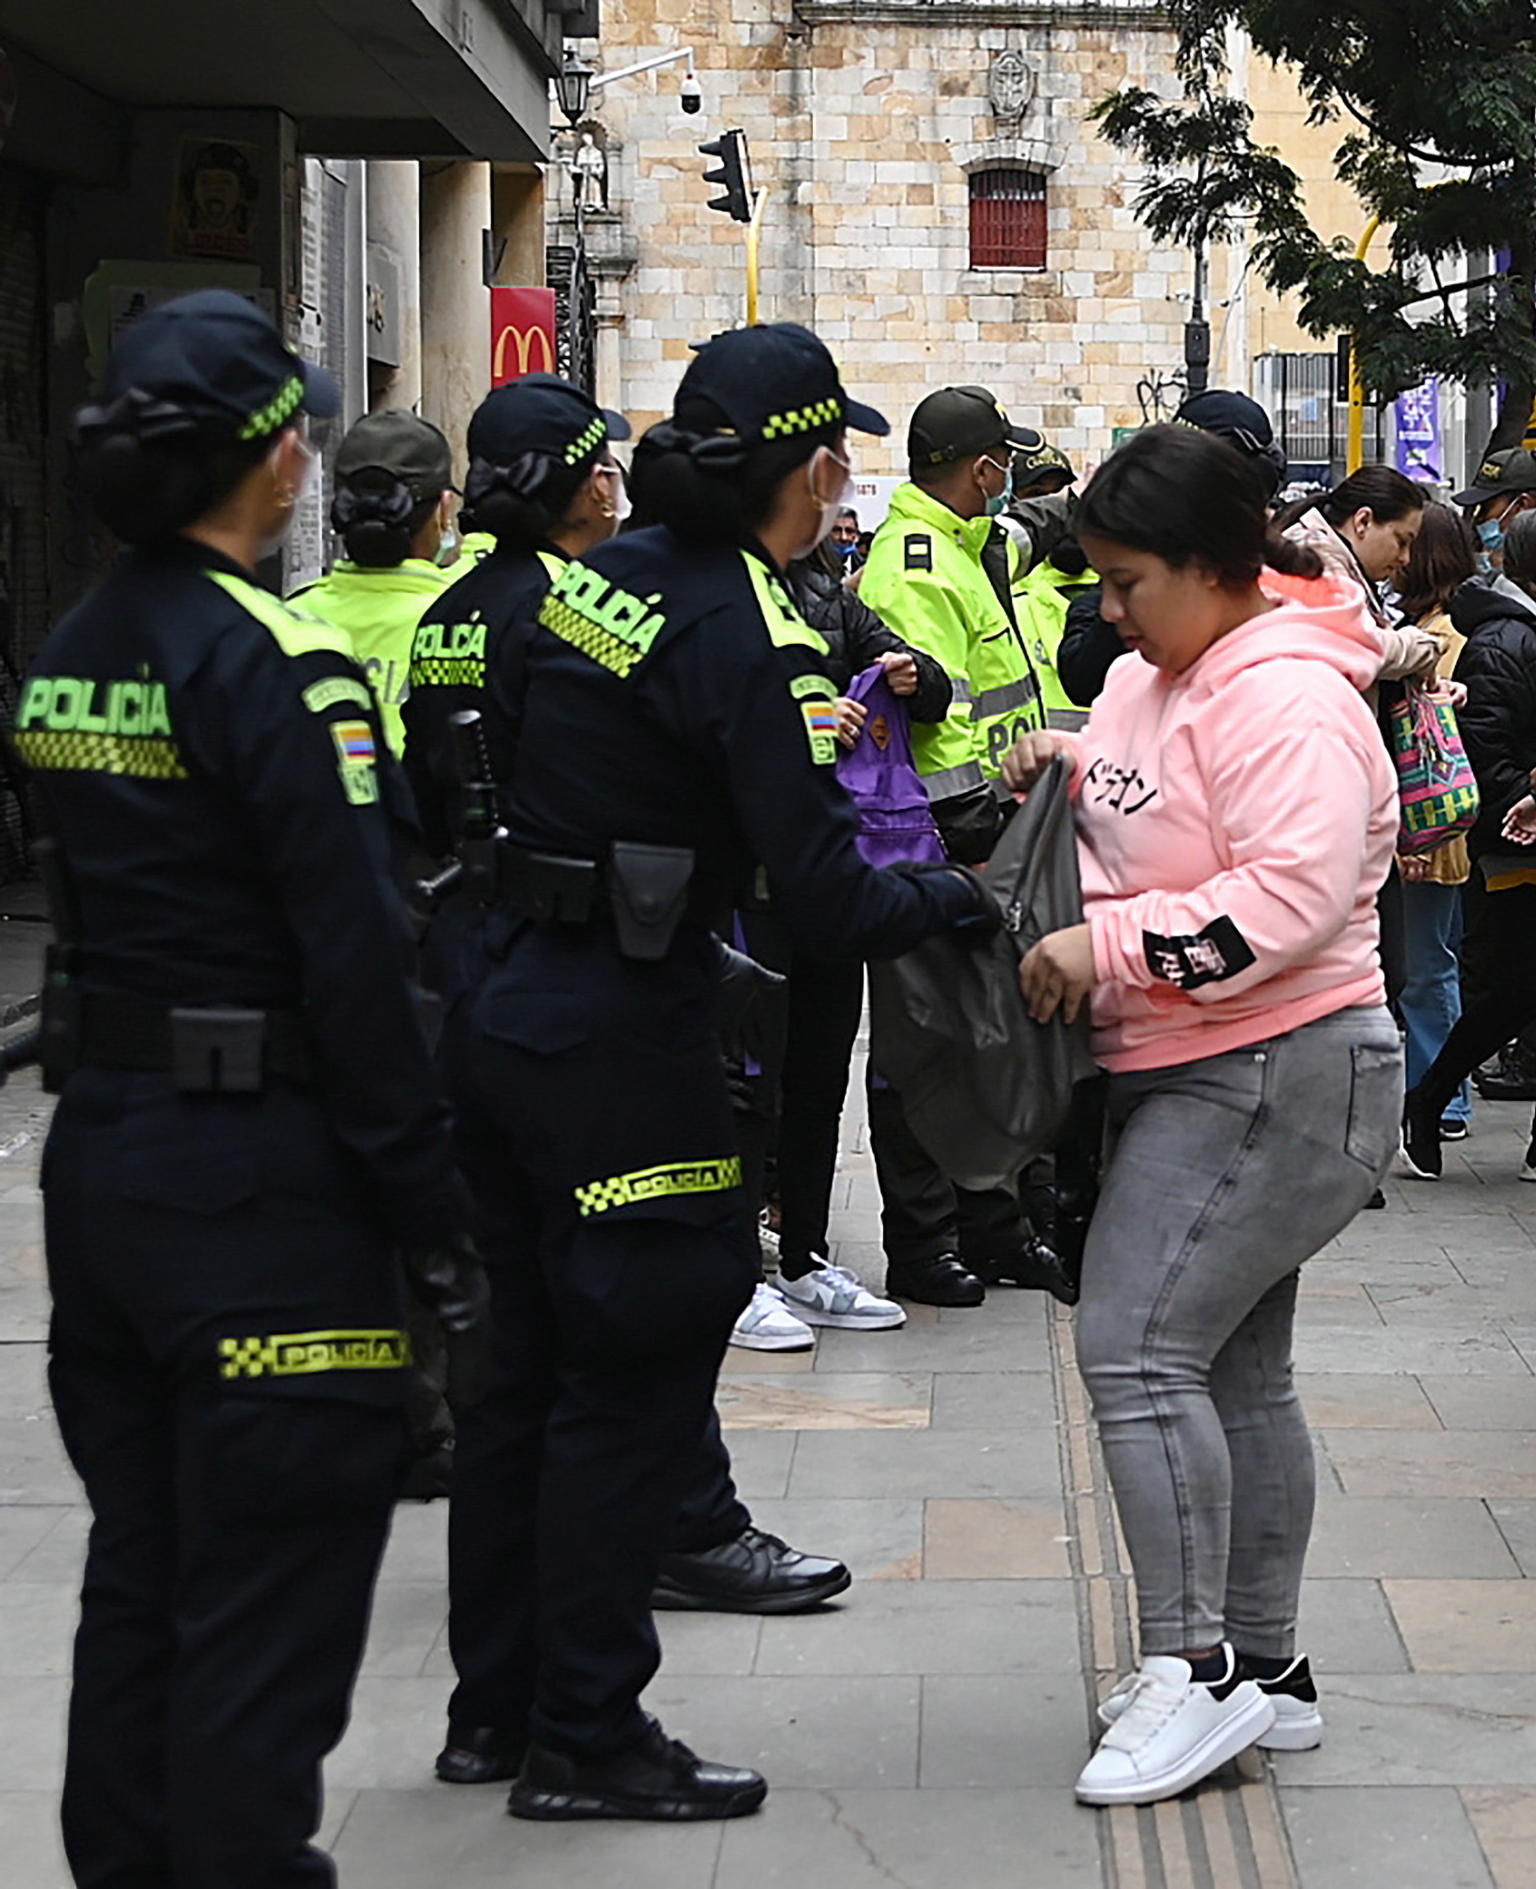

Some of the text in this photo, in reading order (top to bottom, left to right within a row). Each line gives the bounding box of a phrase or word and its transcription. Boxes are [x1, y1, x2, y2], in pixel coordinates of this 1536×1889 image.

[551, 560, 666, 654] POLICÍA
[18, 662, 173, 736] POLICÍA
[285, 1338, 394, 1366] POLICÍA
